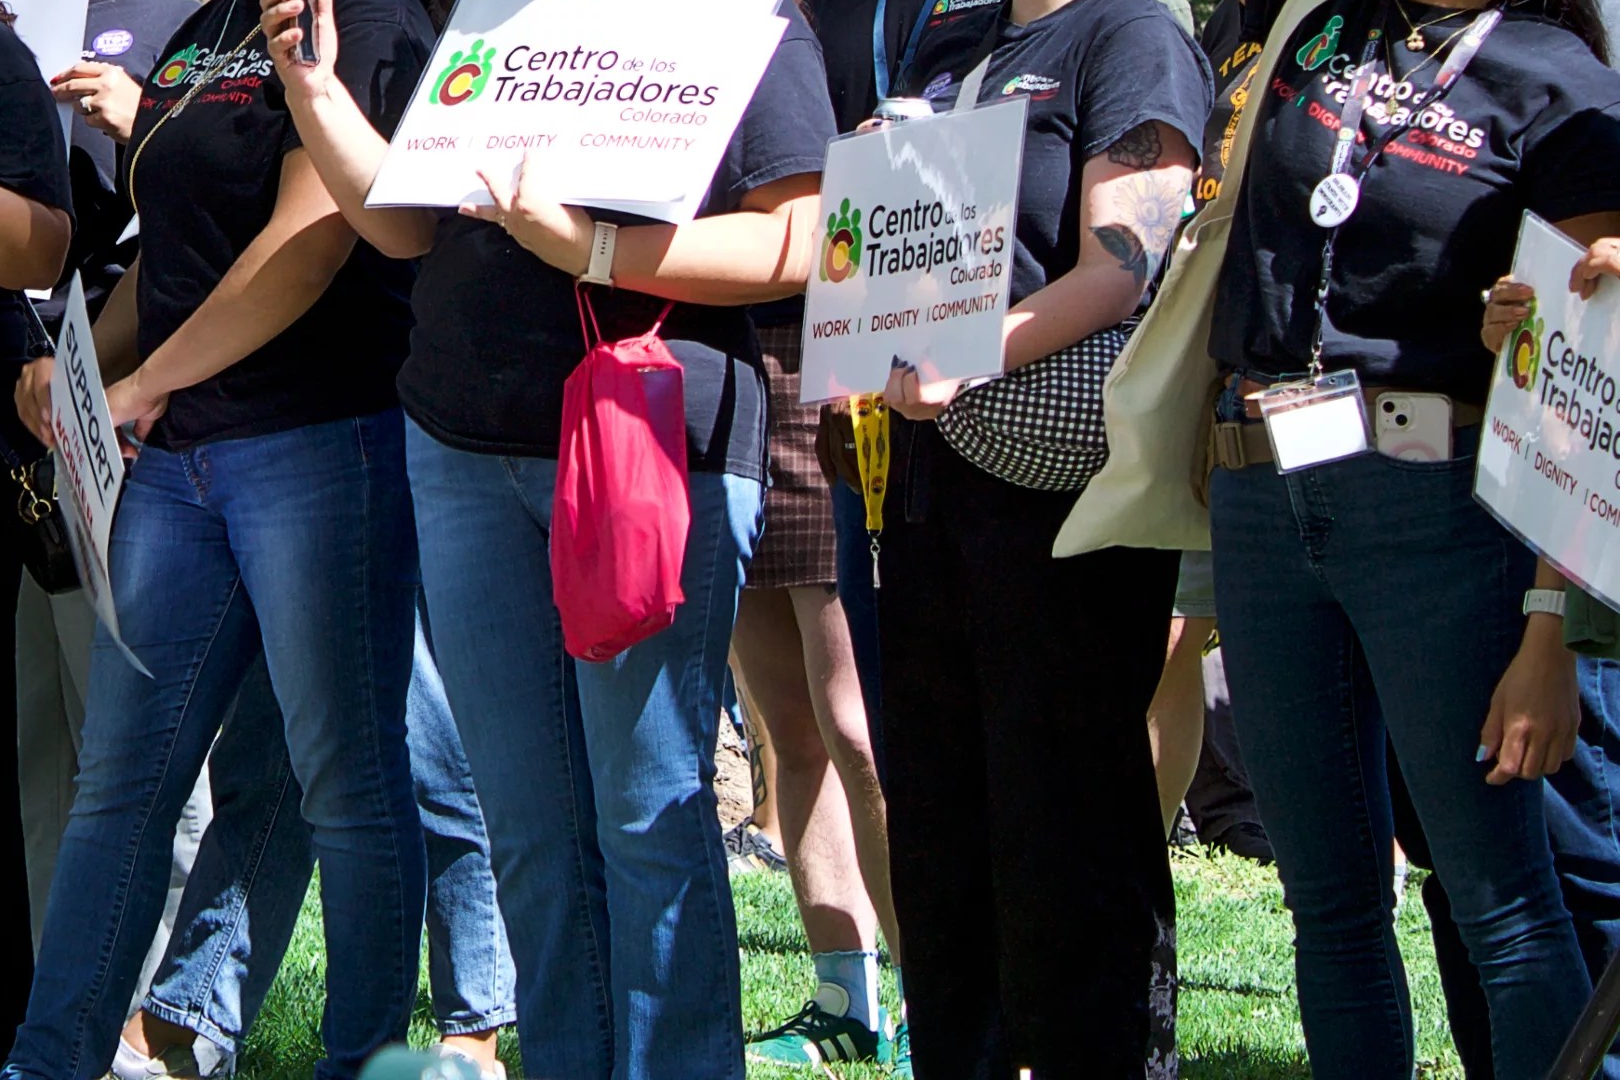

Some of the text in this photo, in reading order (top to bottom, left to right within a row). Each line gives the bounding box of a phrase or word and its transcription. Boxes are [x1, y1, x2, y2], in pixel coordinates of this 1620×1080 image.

[503, 45, 677, 73] Centro de los
[494, 74, 719, 107] Trabajadores
[619, 107, 708, 126] Colorado
[407, 133, 696, 151] WORK DIGNITY COMMUNITY
[1384, 141, 1469, 176] OMMUNITY
[868, 199, 943, 239] Centro
[960, 203, 977, 220] los
[866, 225, 1005, 277] Trabajadores
[950, 259, 1002, 285] Colorado
[813, 293, 998, 339] WORK DIGNITY COMMUNITY
[1547, 330, 1616, 407] Centro
[65, 320, 115, 491] SUPPORT
[1492, 416, 1523, 454] WORK
[1534, 452, 1578, 496] DIGNITY
